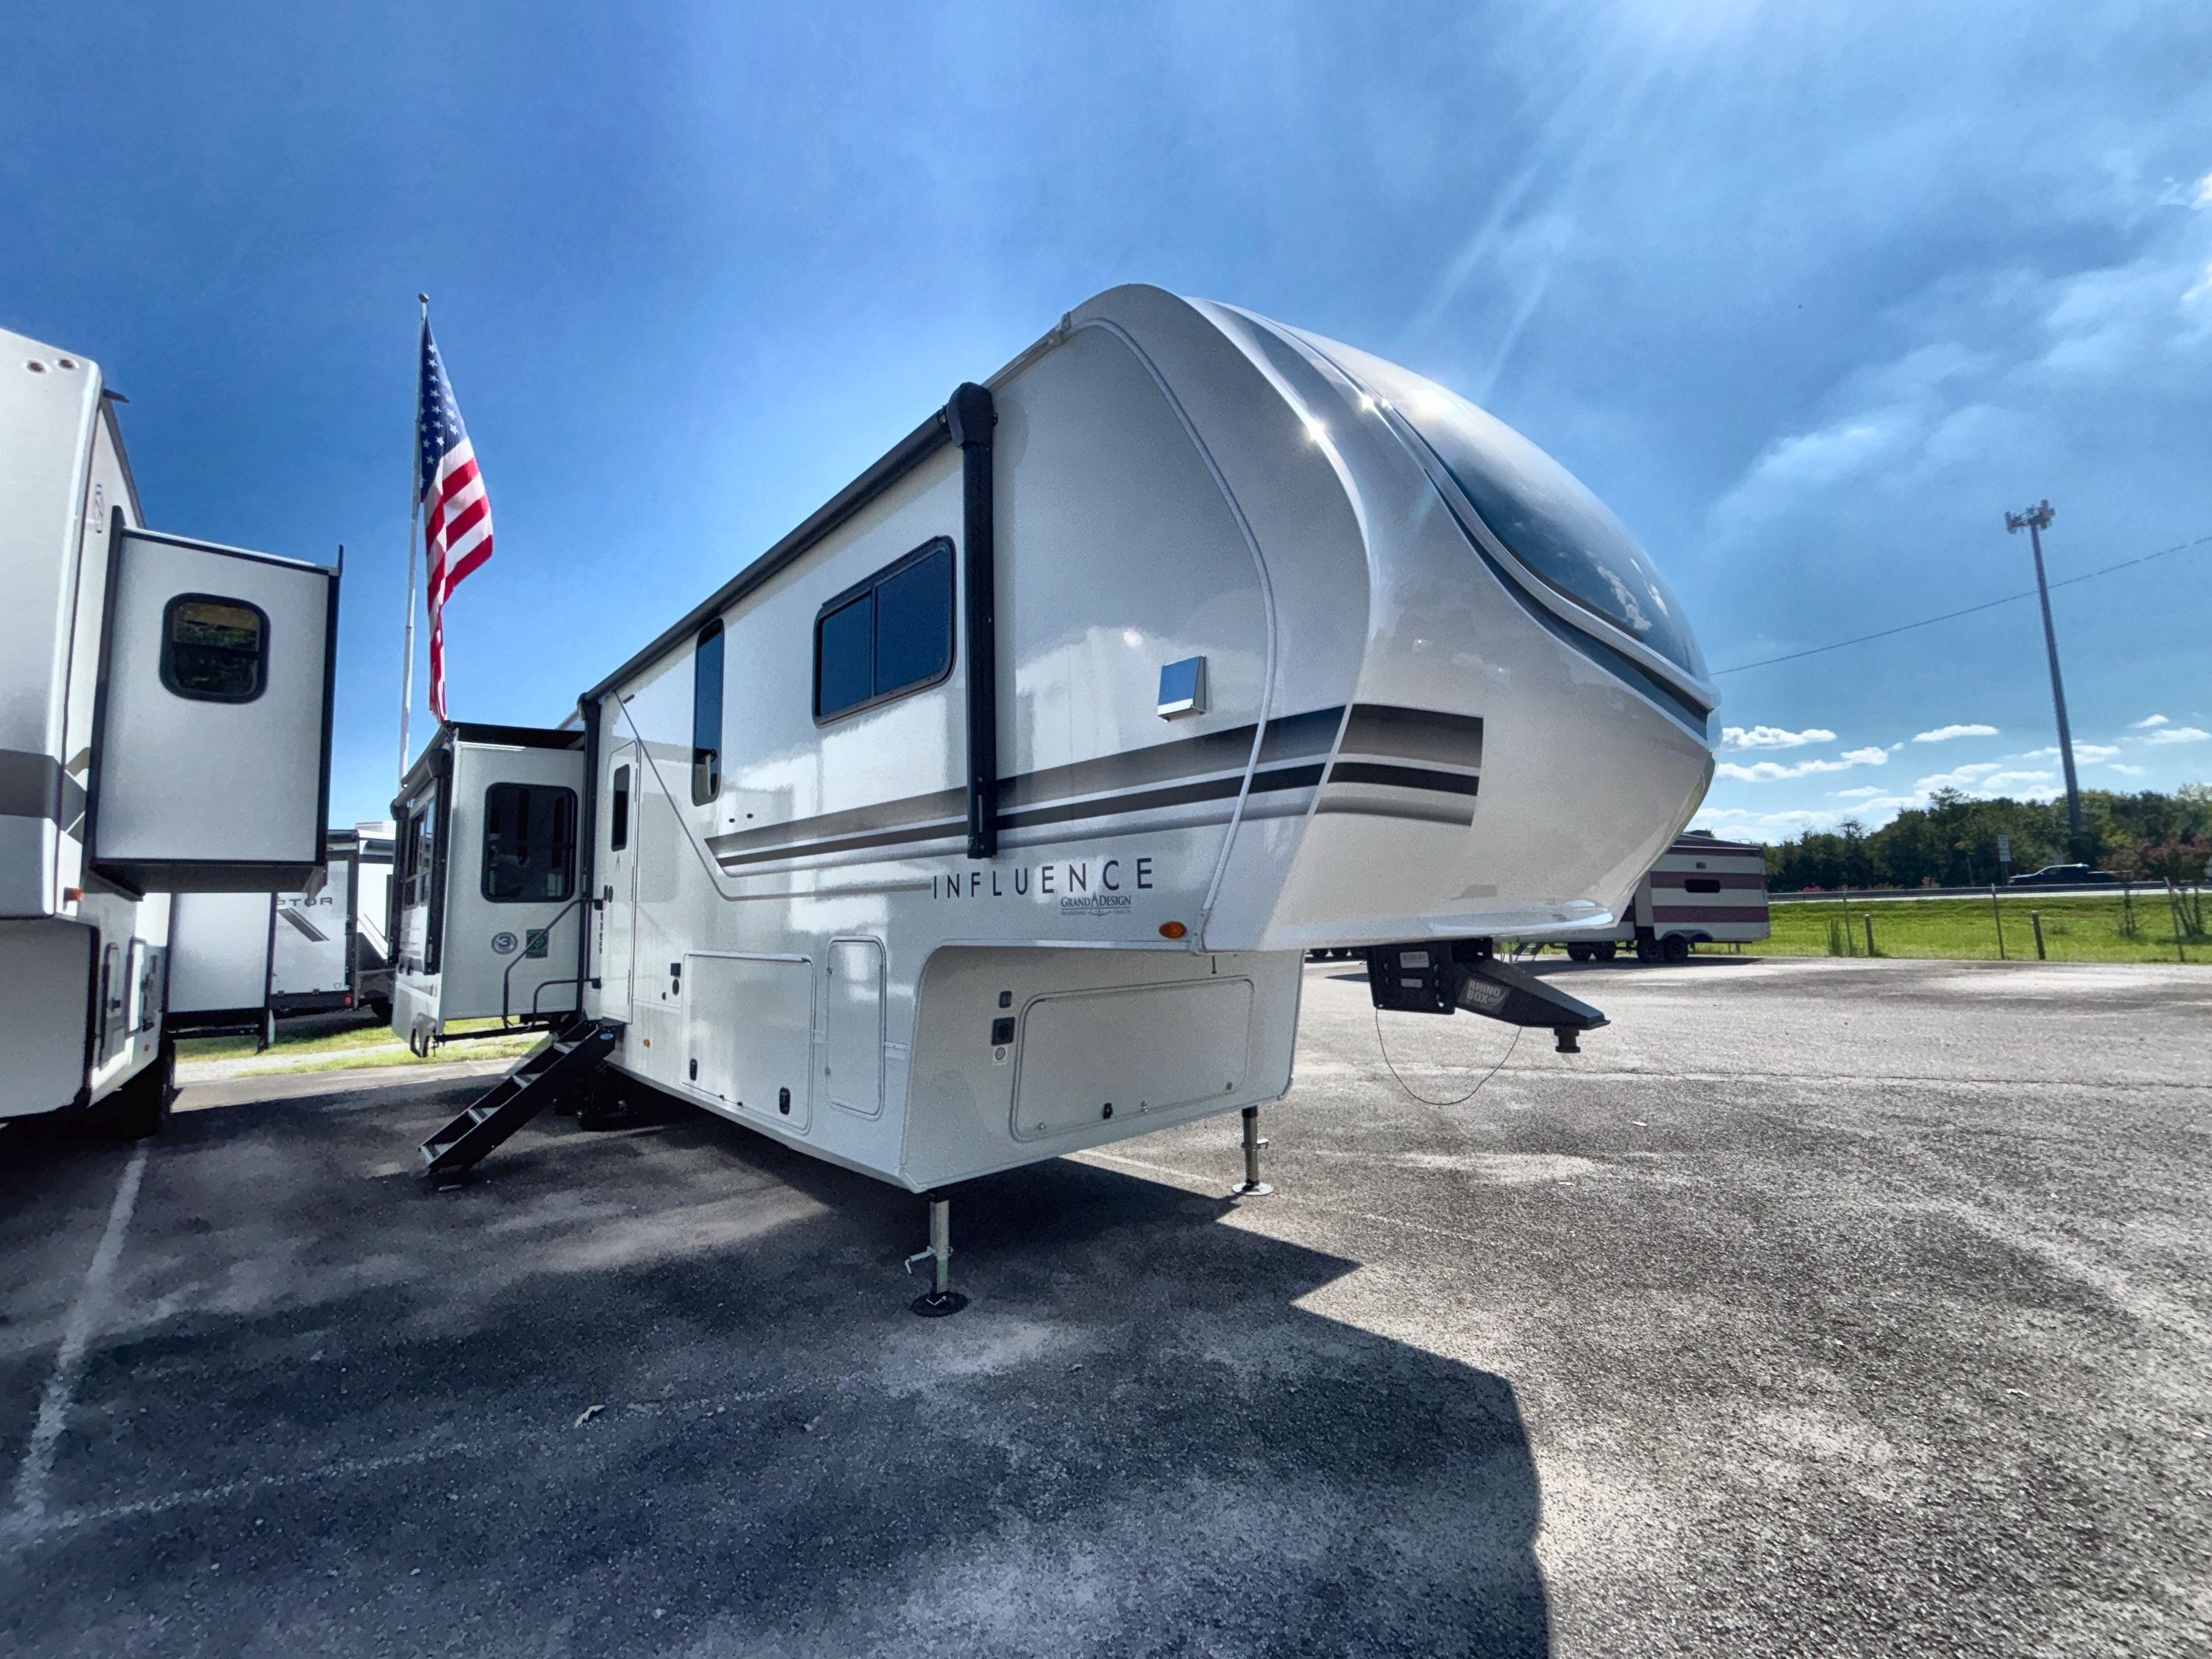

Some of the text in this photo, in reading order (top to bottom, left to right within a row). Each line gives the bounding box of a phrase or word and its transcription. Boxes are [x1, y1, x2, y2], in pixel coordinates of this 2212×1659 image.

[933, 858, 1152, 899] INFLUENCE
[1060, 894, 1131, 908] GRAND DESIGN
[1468, 979, 1501, 997] RHINO
[1466, 990, 1489, 1004] BOX
